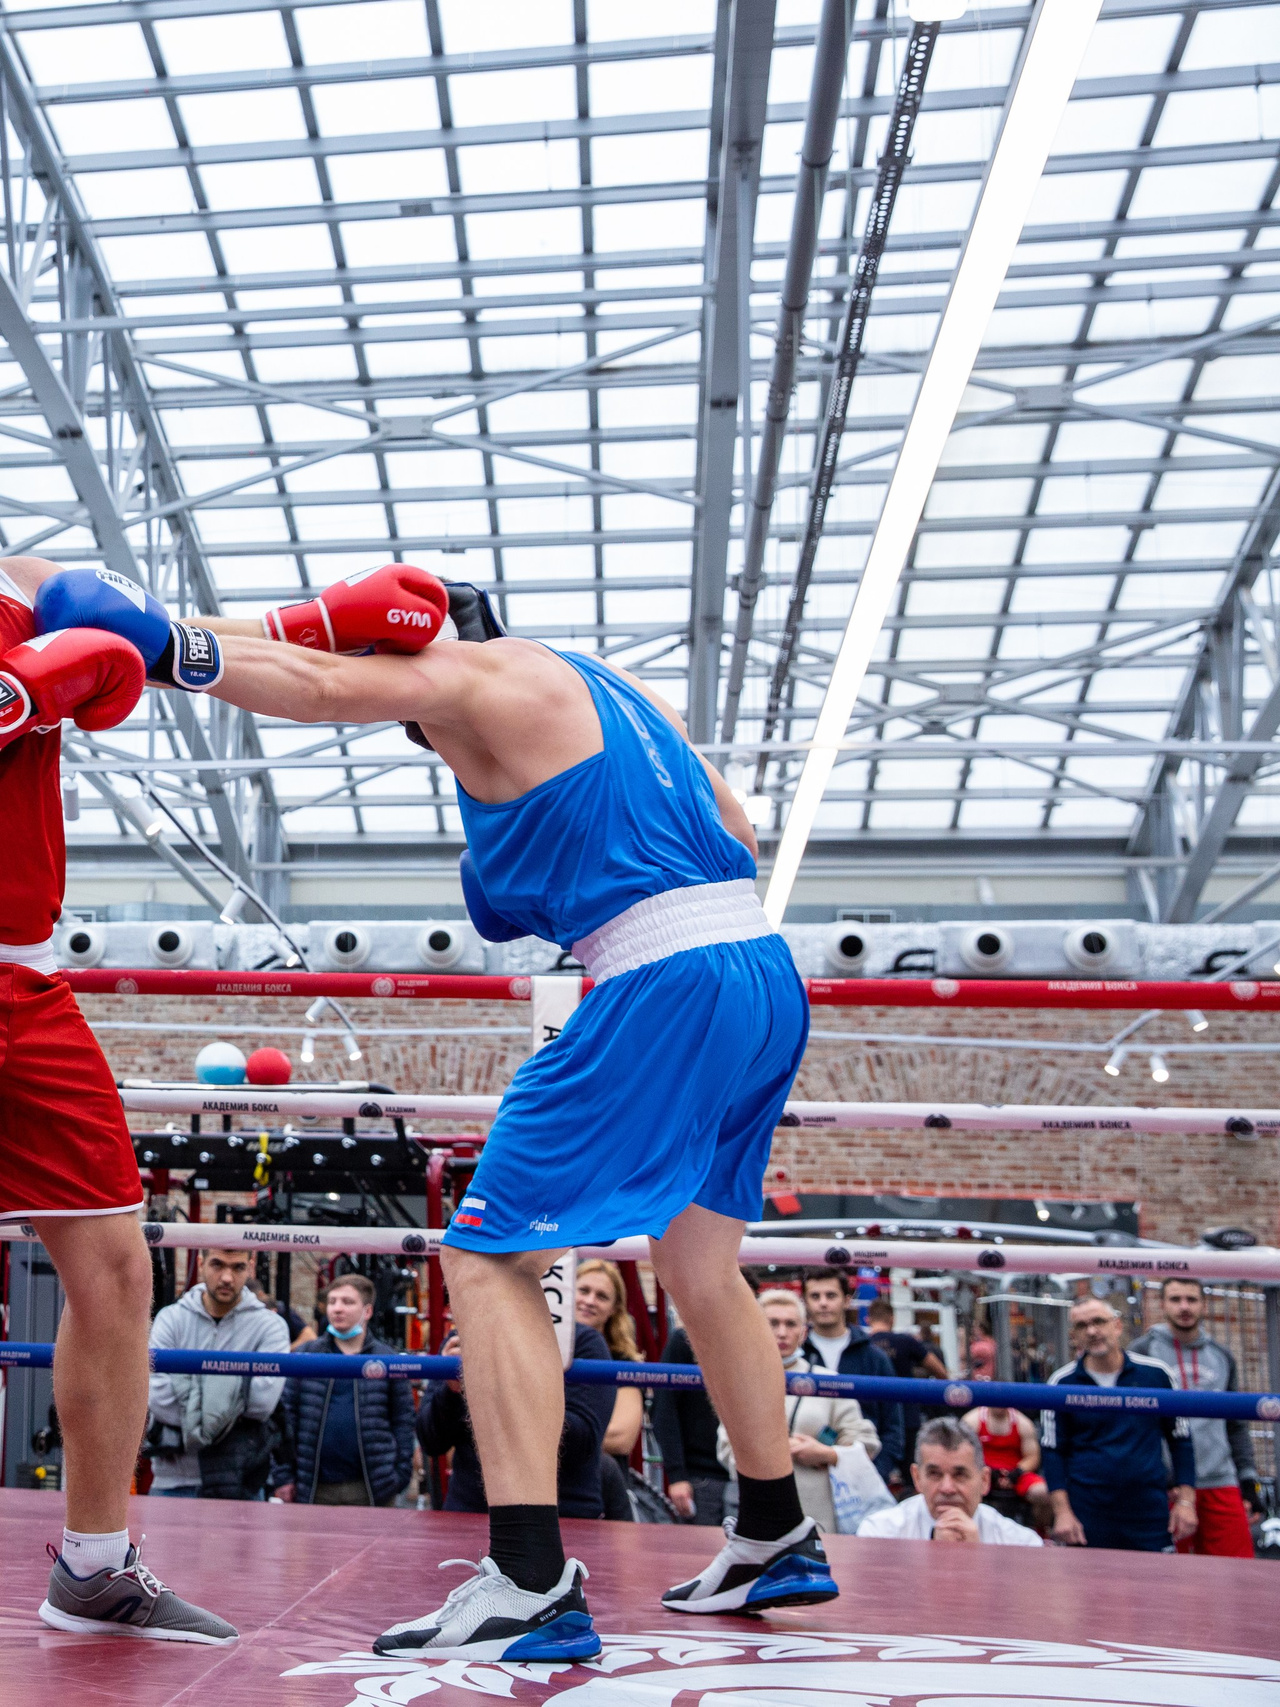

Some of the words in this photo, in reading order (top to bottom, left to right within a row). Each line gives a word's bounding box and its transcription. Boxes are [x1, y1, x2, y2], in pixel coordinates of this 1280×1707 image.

[386, 608, 432, 629] GYM
[215, 983, 263, 994] АКАДЕМИЯ
[264, 983, 292, 993] БОКСА
[201, 1101, 250, 1112] АКАДЕМИЯ
[251, 1102, 280, 1113] БОКСА
[242, 1230, 291, 1243] АКАДЕМИЯ
[292, 1233, 321, 1245] БОКСА
[201, 1359, 250, 1373] АКАДЕМИЯ
[251, 1362, 281, 1373] БОКСА
[616, 1370, 669, 1383] АКАДЕМИЯ
[669, 1373, 701, 1385] БОКСА
